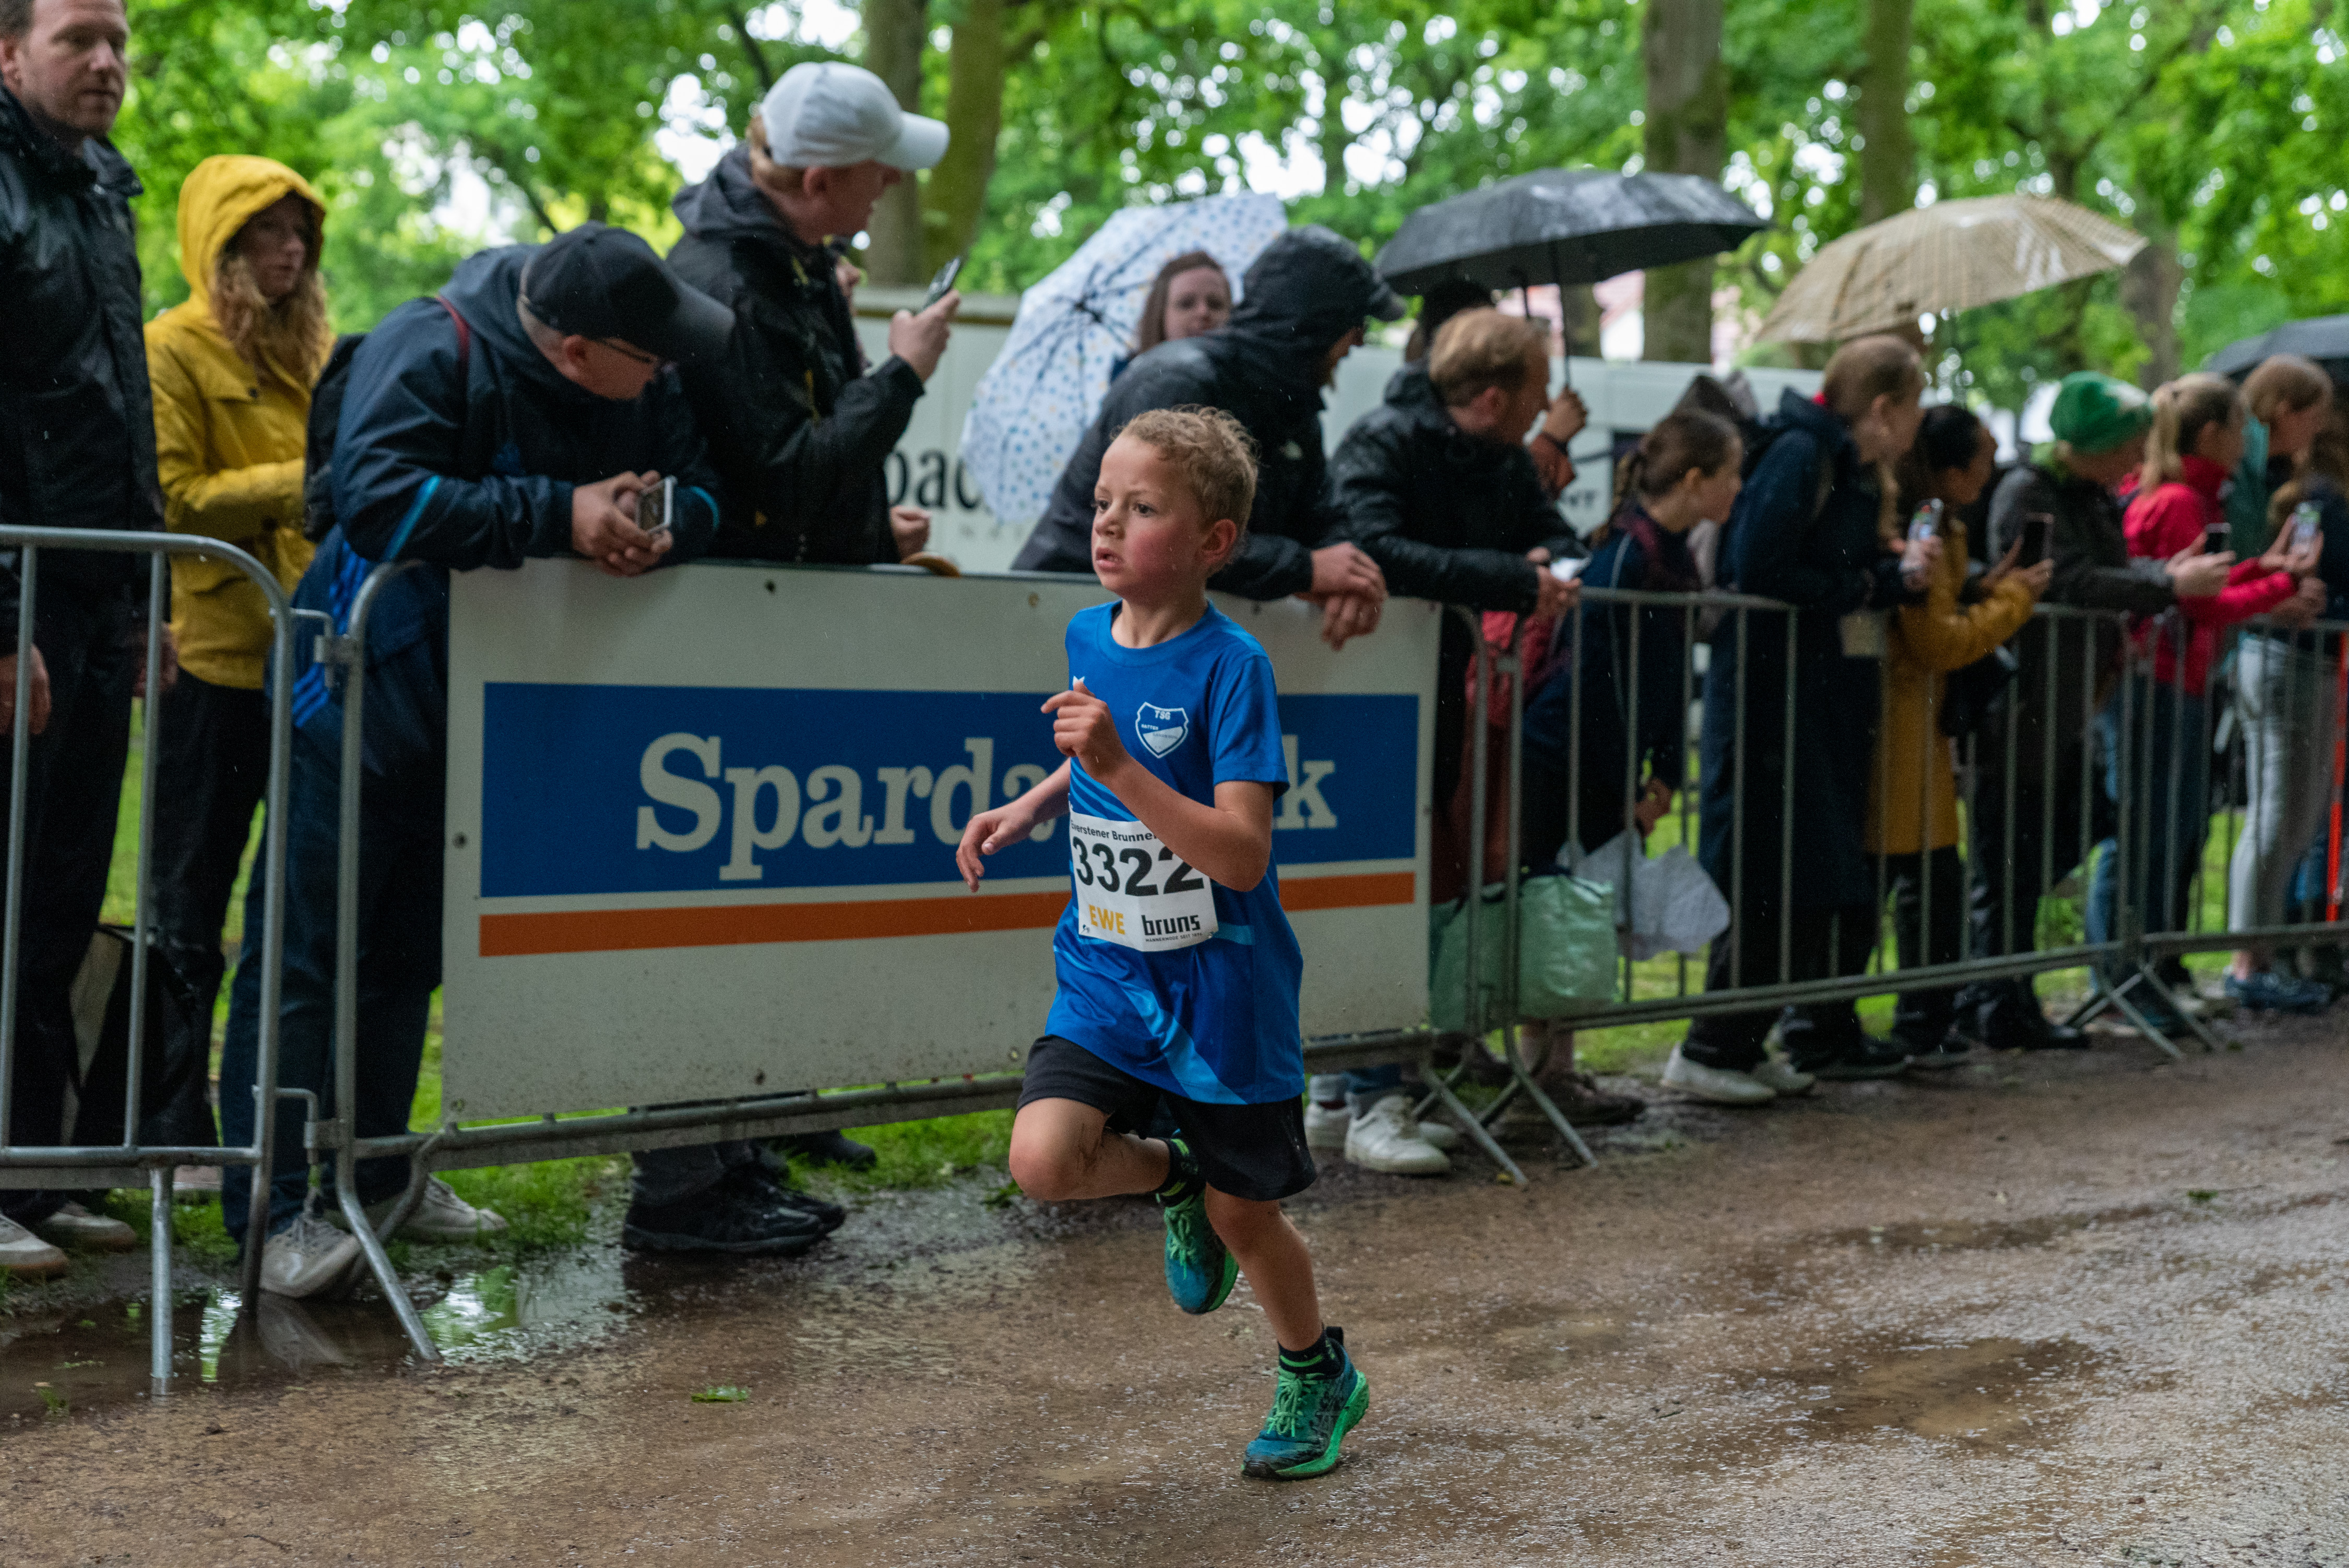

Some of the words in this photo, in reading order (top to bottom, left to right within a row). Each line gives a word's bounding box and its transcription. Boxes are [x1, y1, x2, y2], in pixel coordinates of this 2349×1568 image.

[1155, 710, 1170, 720] TSG
[1111, 830, 1157, 842] Brunne
[1073, 836, 1204, 896] 3322
[1089, 905, 1125, 935] EWE
[1141, 914, 1200, 936] bruns
